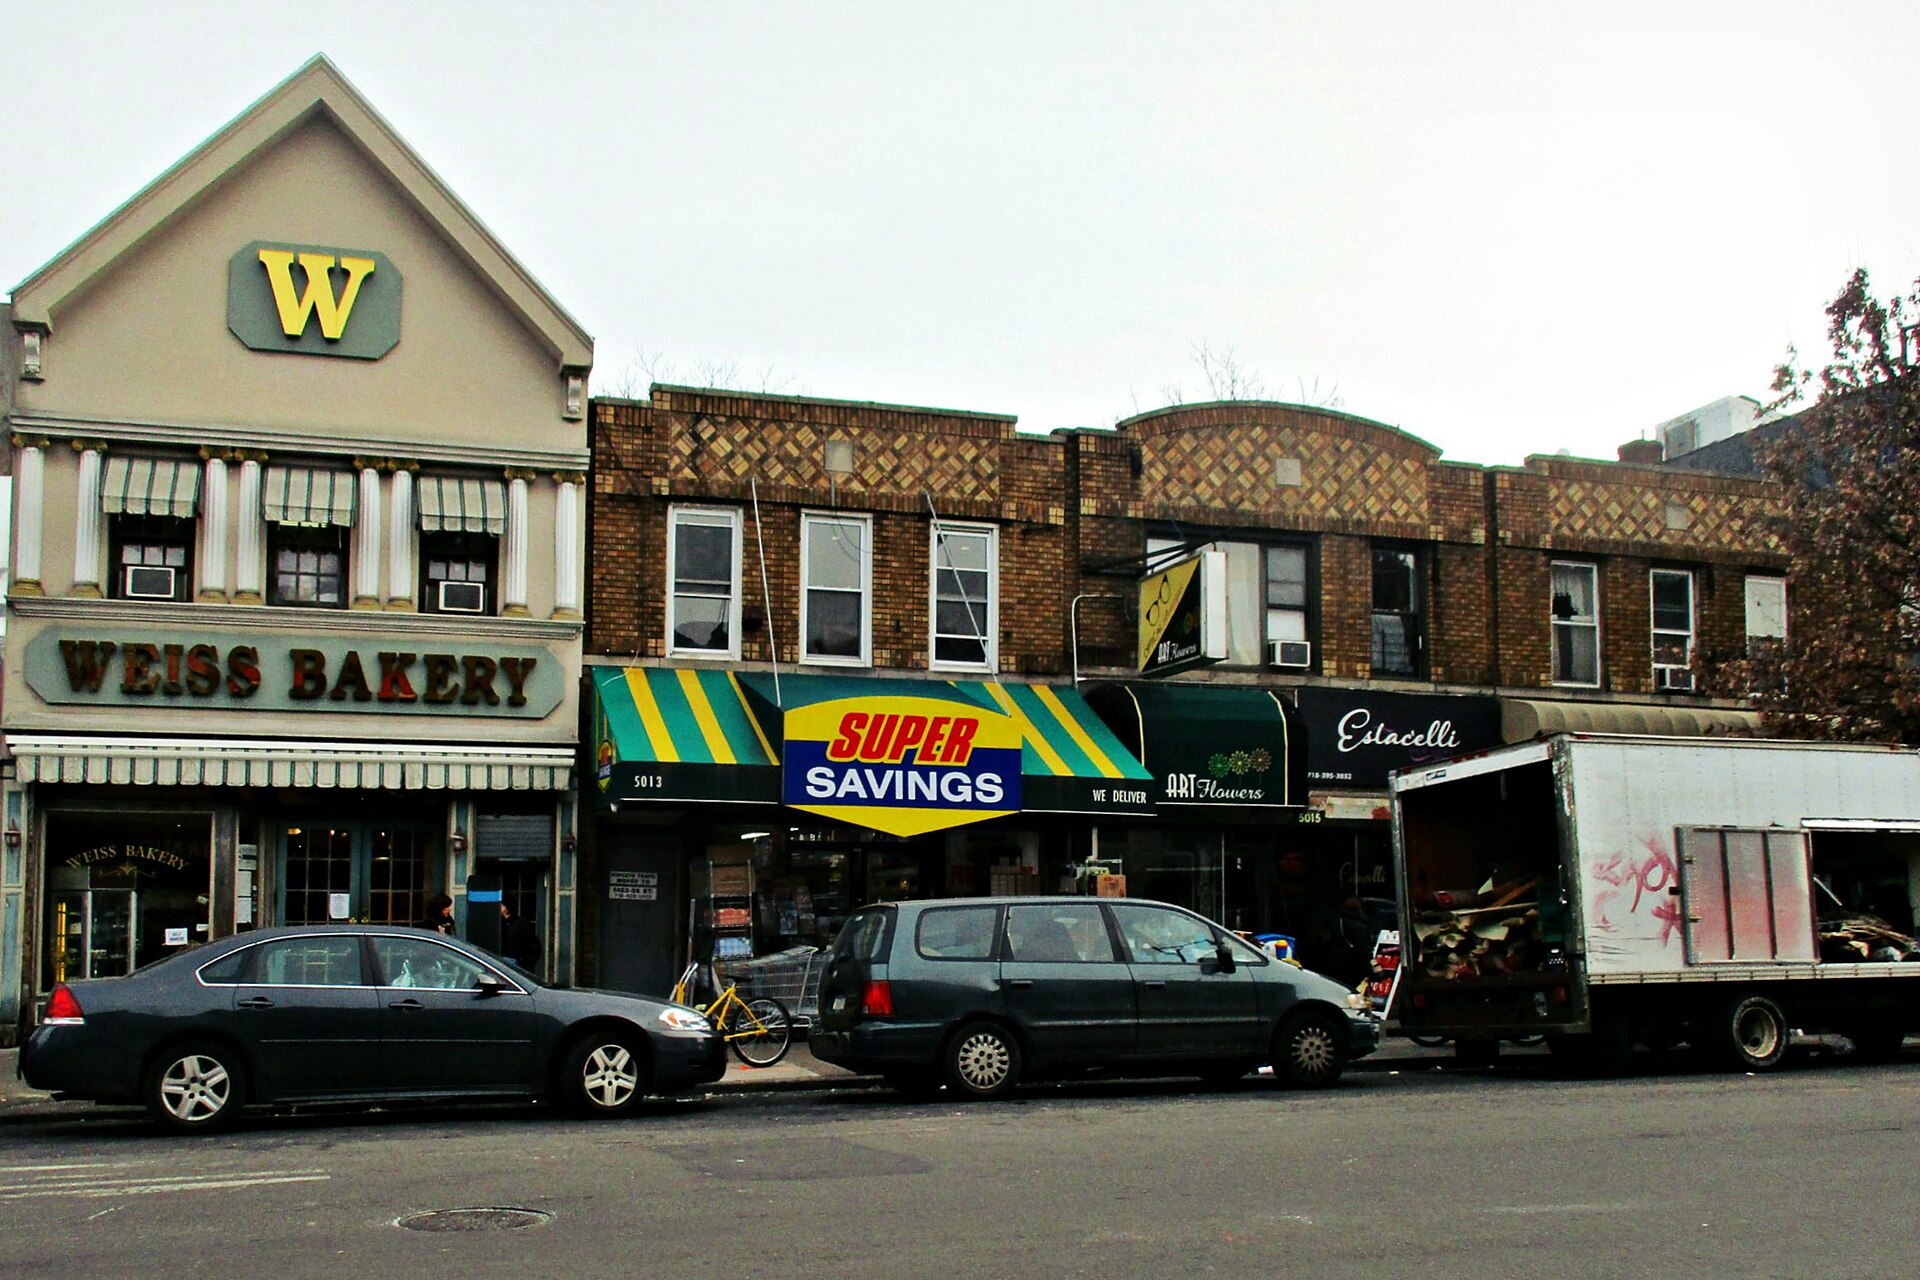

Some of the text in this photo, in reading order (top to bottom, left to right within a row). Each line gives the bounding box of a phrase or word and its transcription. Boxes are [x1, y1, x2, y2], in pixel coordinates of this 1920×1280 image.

[257, 248, 376, 340] W
[58, 639, 538, 708] WEISS BAKERY
[829, 712, 979, 764] SUPER
[1337, 708, 1461, 753] Estacelli
[634, 775, 662, 788] 5013
[805, 767, 1004, 803] SAVINGS
[1092, 789, 1147, 804] WE DELIVER
[1165, 773, 1265, 800] ART Flowers
[1299, 813, 1321, 823] 5015
[65, 844, 189, 871] WEISS BAKERY
